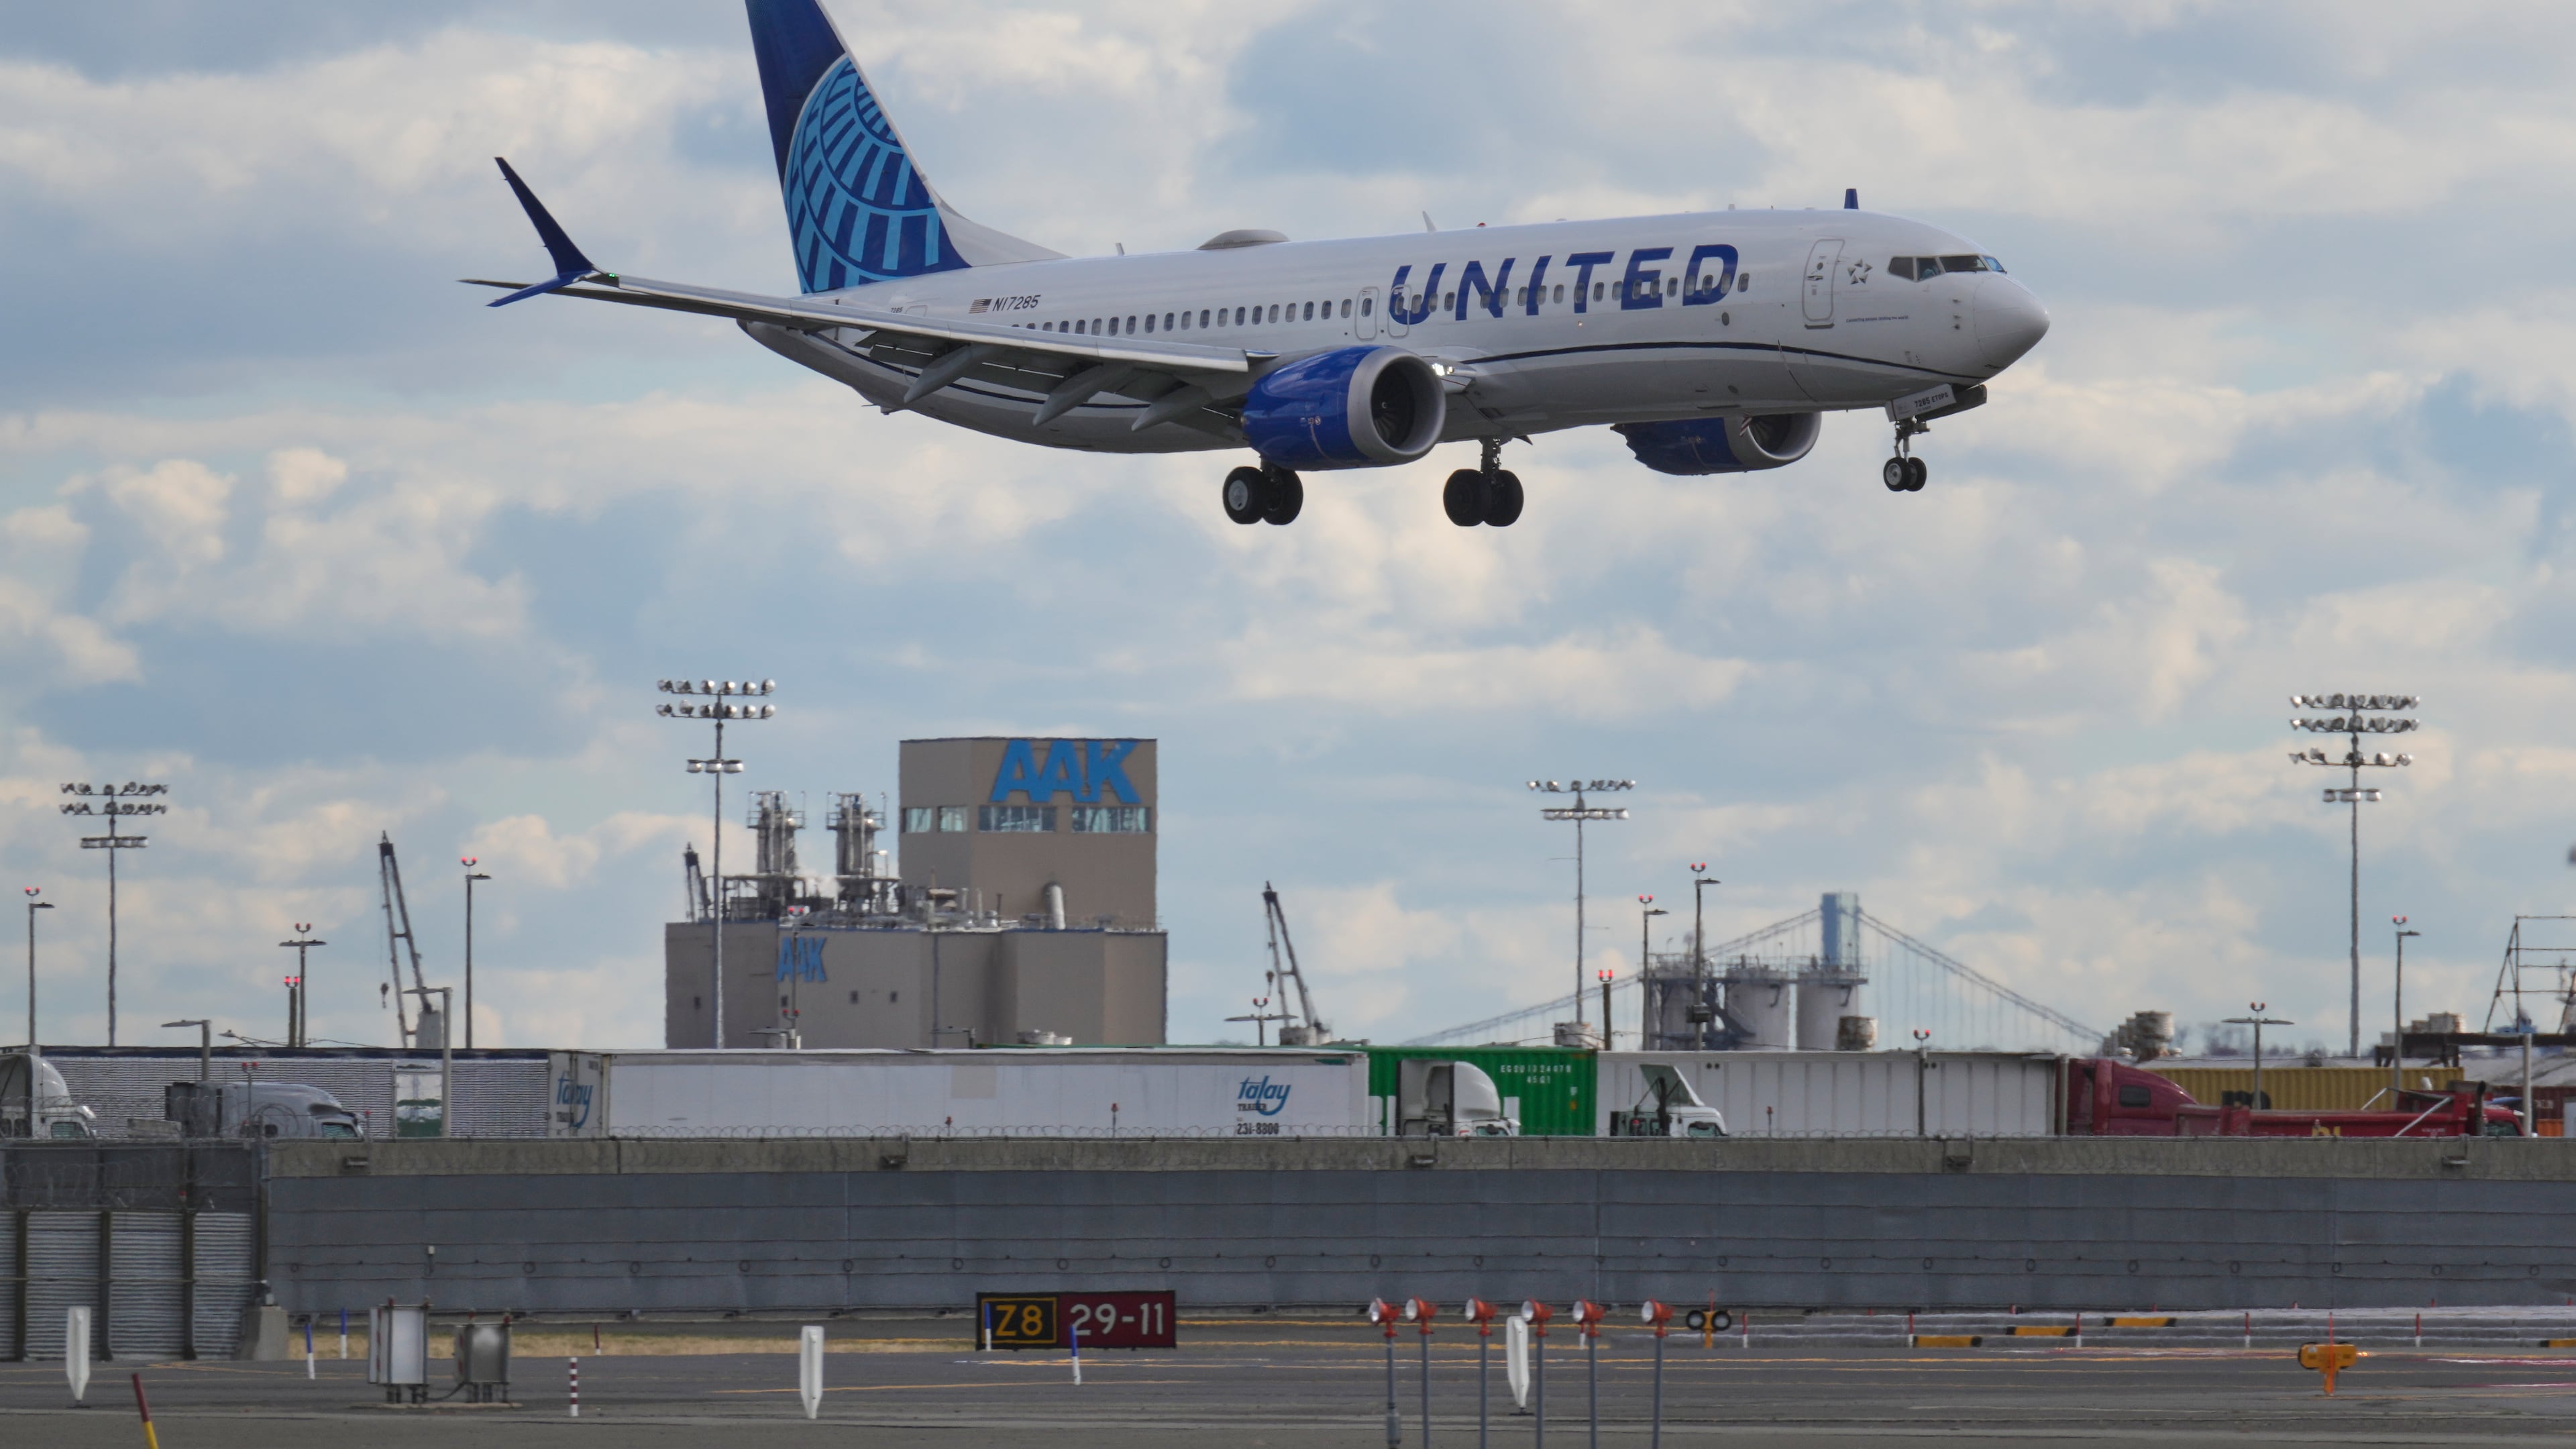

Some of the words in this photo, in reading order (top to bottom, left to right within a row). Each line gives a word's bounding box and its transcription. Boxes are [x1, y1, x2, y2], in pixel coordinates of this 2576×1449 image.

[992, 294, 1041, 311] N17285
[1389, 244, 1739, 325] UNITED
[1914, 396, 1931, 408] 7285
[989, 739, 1142, 804] AAK
[776, 936, 828, 983] AAK
[556, 1070, 593, 1129] taay
[1237, 1075, 1291, 1116] talay
[996, 1304, 1043, 1336] Z8
[1070, 1303, 1164, 1336] 29-11
